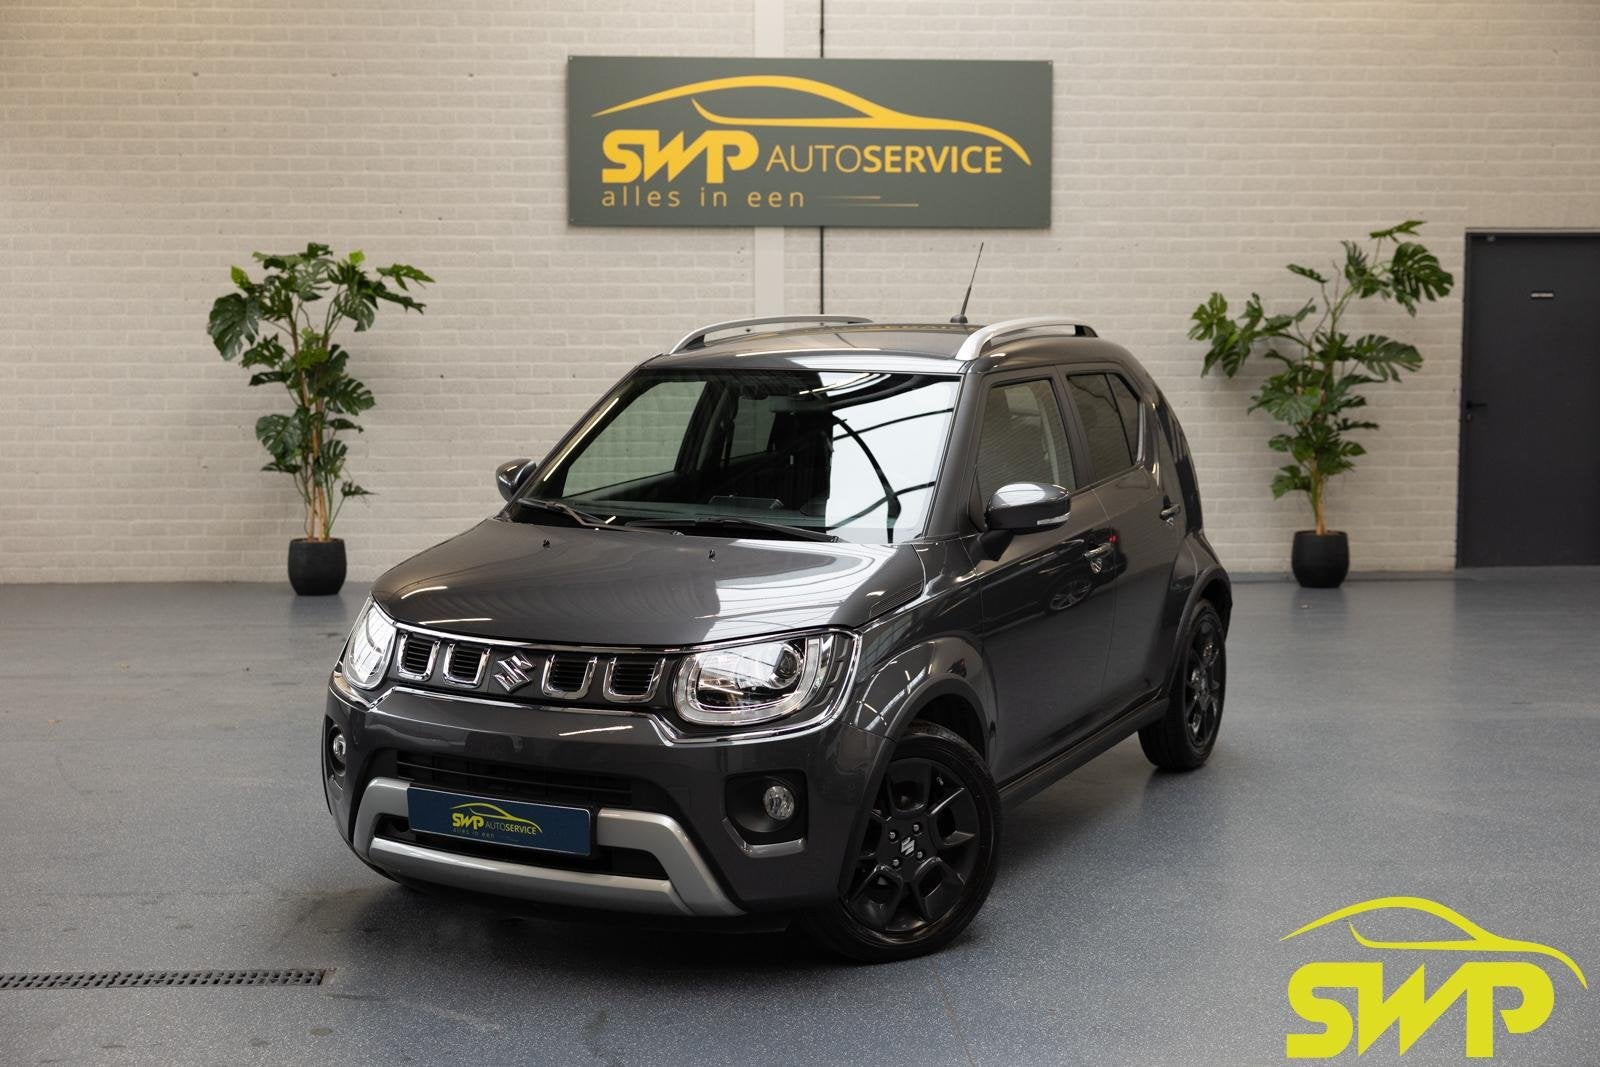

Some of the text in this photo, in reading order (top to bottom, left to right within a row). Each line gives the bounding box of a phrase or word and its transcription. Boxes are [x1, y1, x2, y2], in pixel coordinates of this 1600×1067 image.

[601, 129, 1003, 184] SWP AUTOSERVICE
[602, 186, 804, 208] alles in een
[452, 813, 537, 835] SWP AUTOSERVICE
